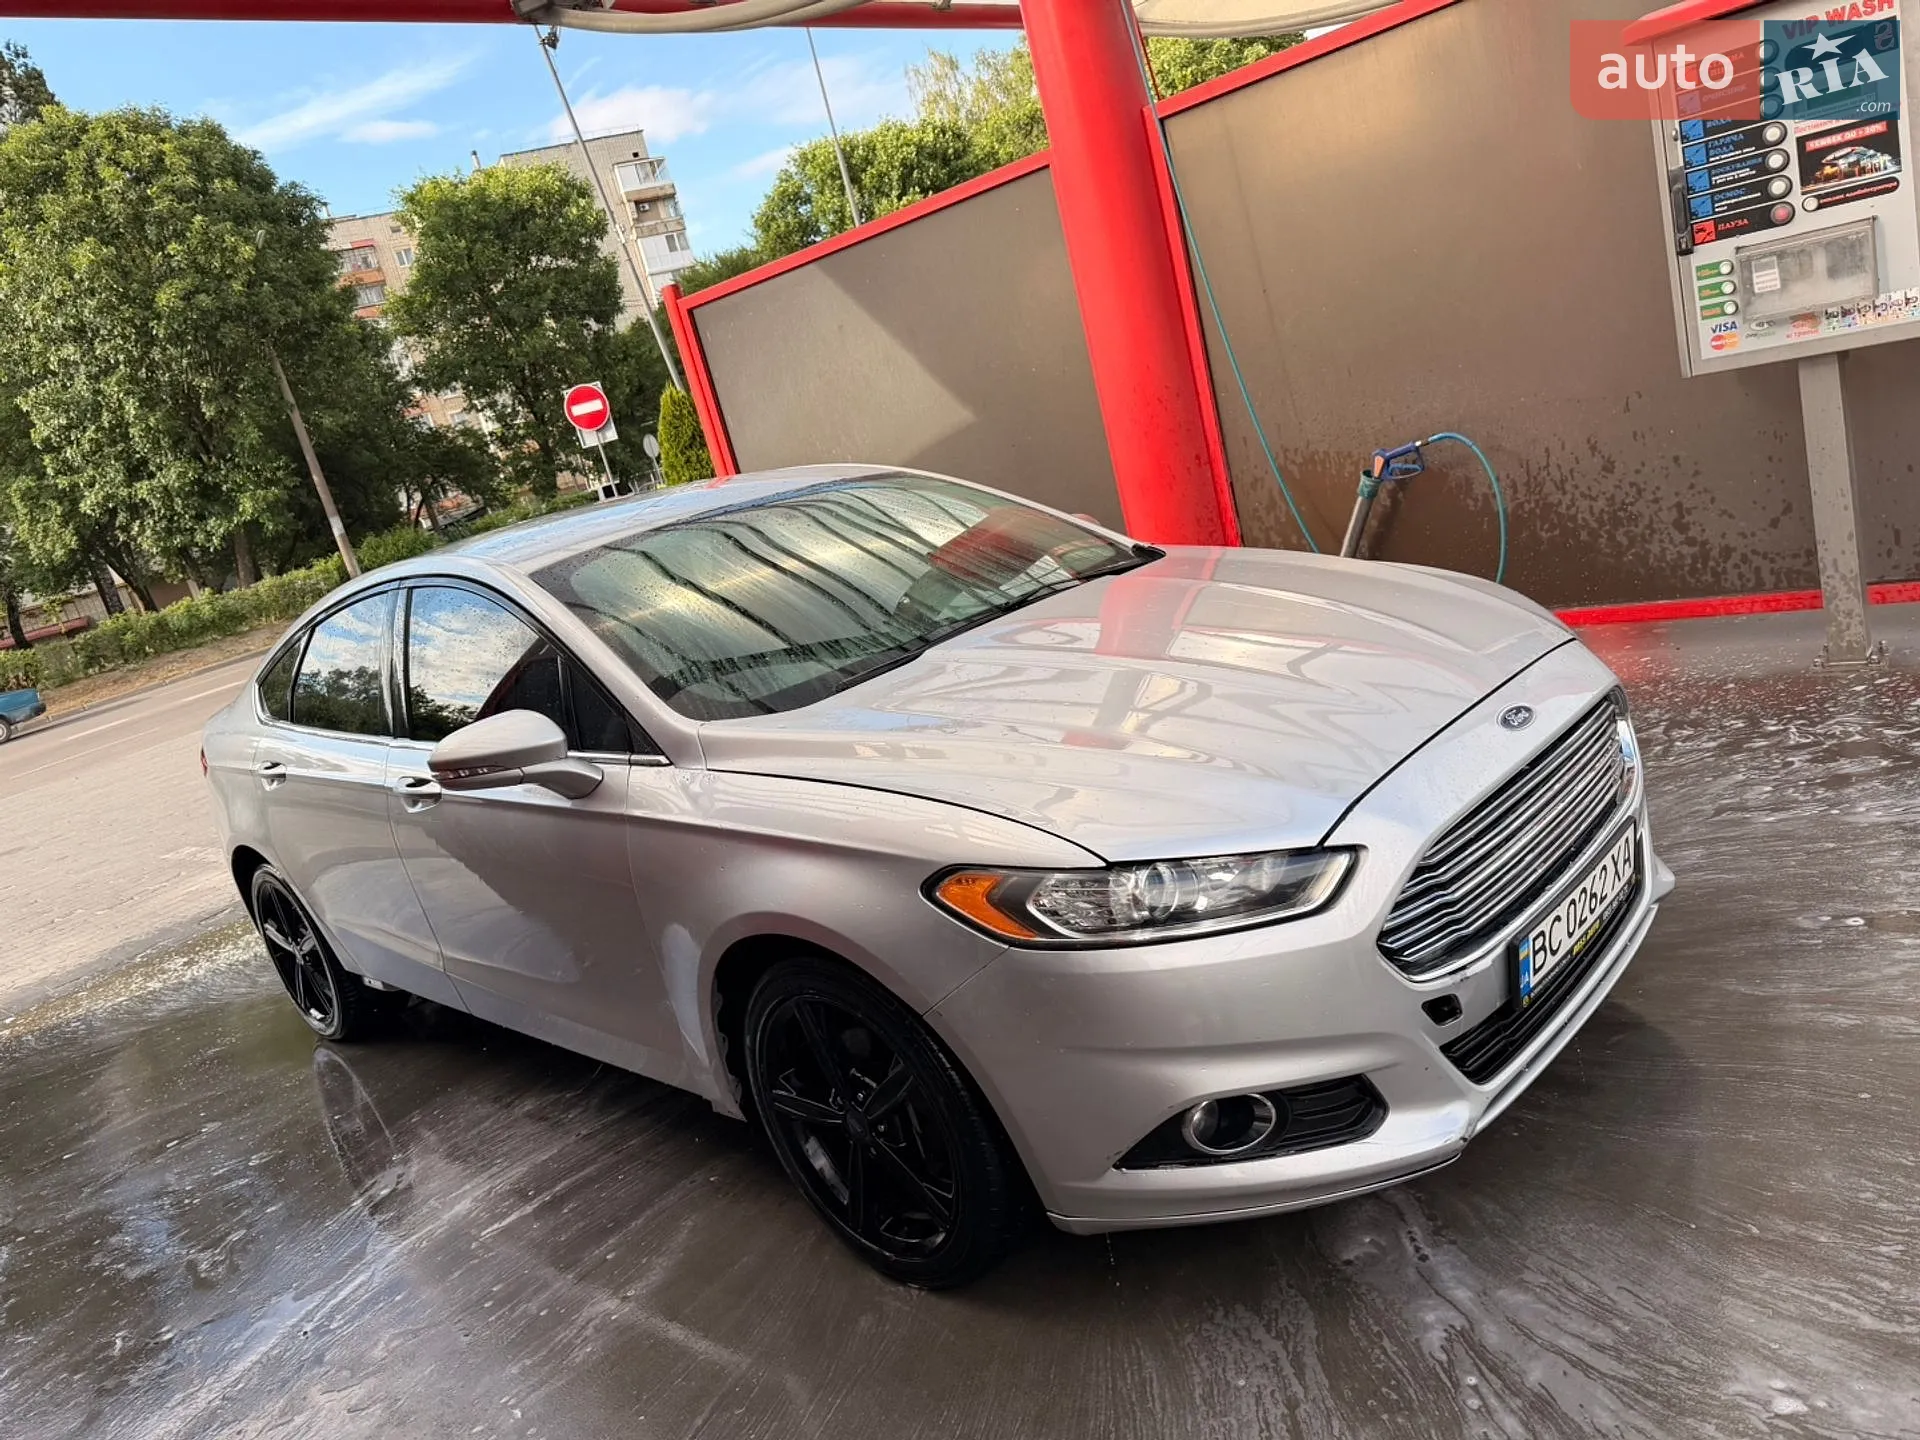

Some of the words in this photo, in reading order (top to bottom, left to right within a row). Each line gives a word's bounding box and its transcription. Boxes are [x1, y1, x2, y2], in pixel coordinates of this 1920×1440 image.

[1782, 15, 1819, 39] VIP
[1825, 0, 1894, 27] WASH
[1718, 218, 1749, 231] ПАУЗА
[1711, 320, 1738, 334] VISA
[1532, 914, 1562, 977] BC
[1566, 864, 1608, 940] 0262
[1611, 836, 1632, 892] XA
